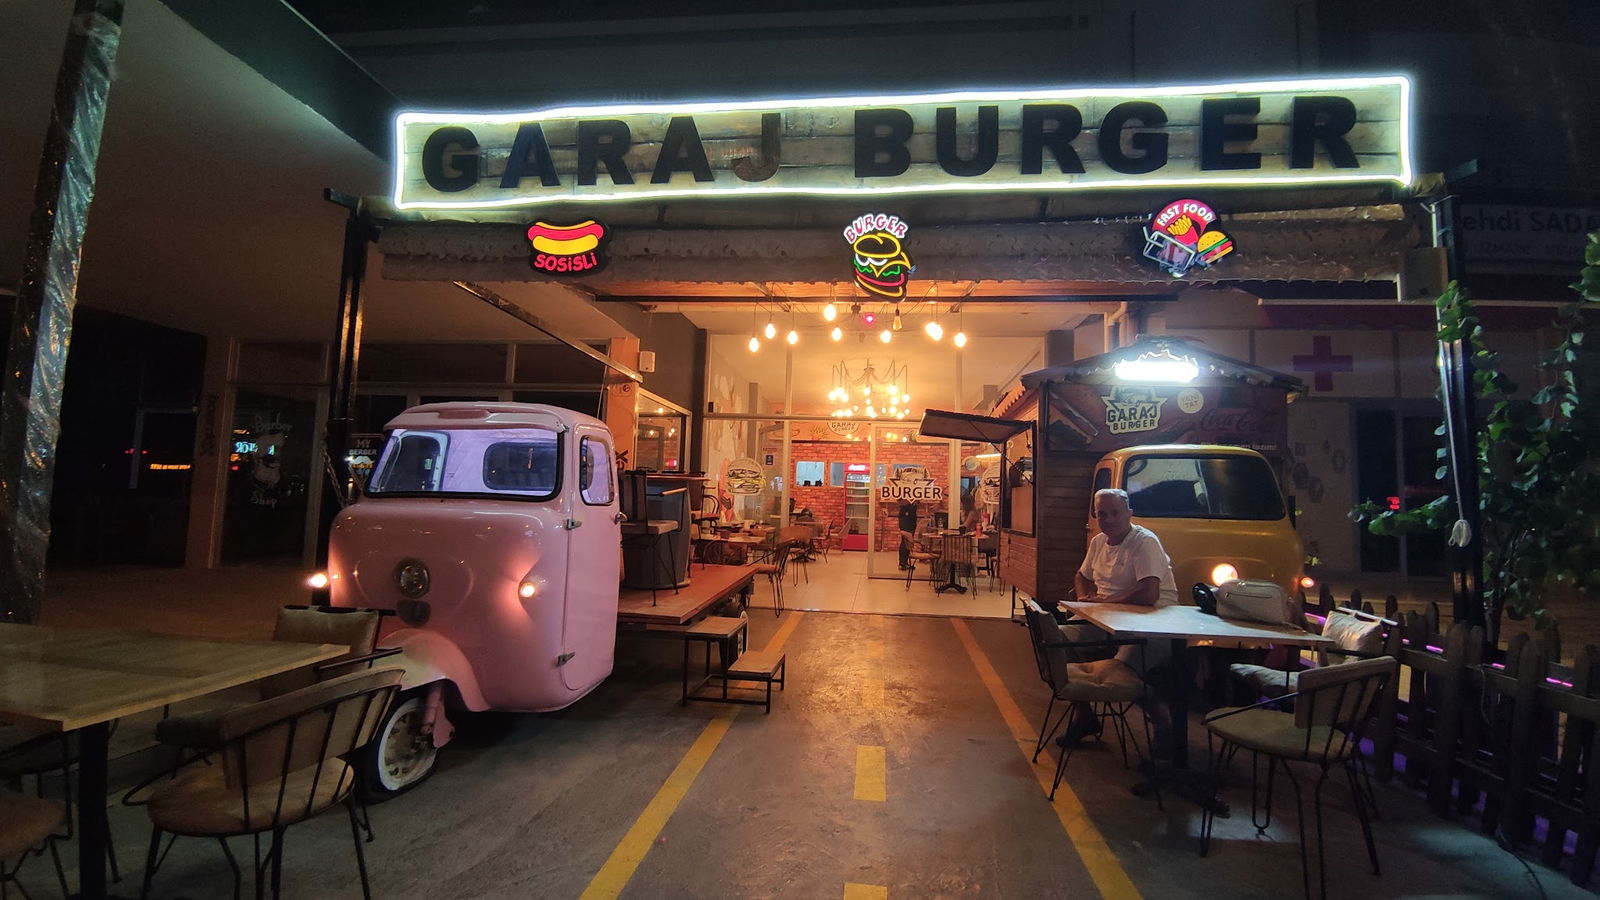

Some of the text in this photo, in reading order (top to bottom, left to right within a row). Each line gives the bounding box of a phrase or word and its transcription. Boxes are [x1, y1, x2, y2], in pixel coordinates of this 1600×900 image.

[422, 94, 1360, 192] GARAJ BURGER
[1157, 203, 1213, 226] FAST FOOD
[1455, 207, 1521, 231] ehdi
[843, 213, 908, 244] BURGER
[1107, 404, 1157, 422] GARAJ
[1113, 419, 1155, 430] BURGER
[357, 439, 371, 448] MY
[881, 486, 941, 499] BURGER
